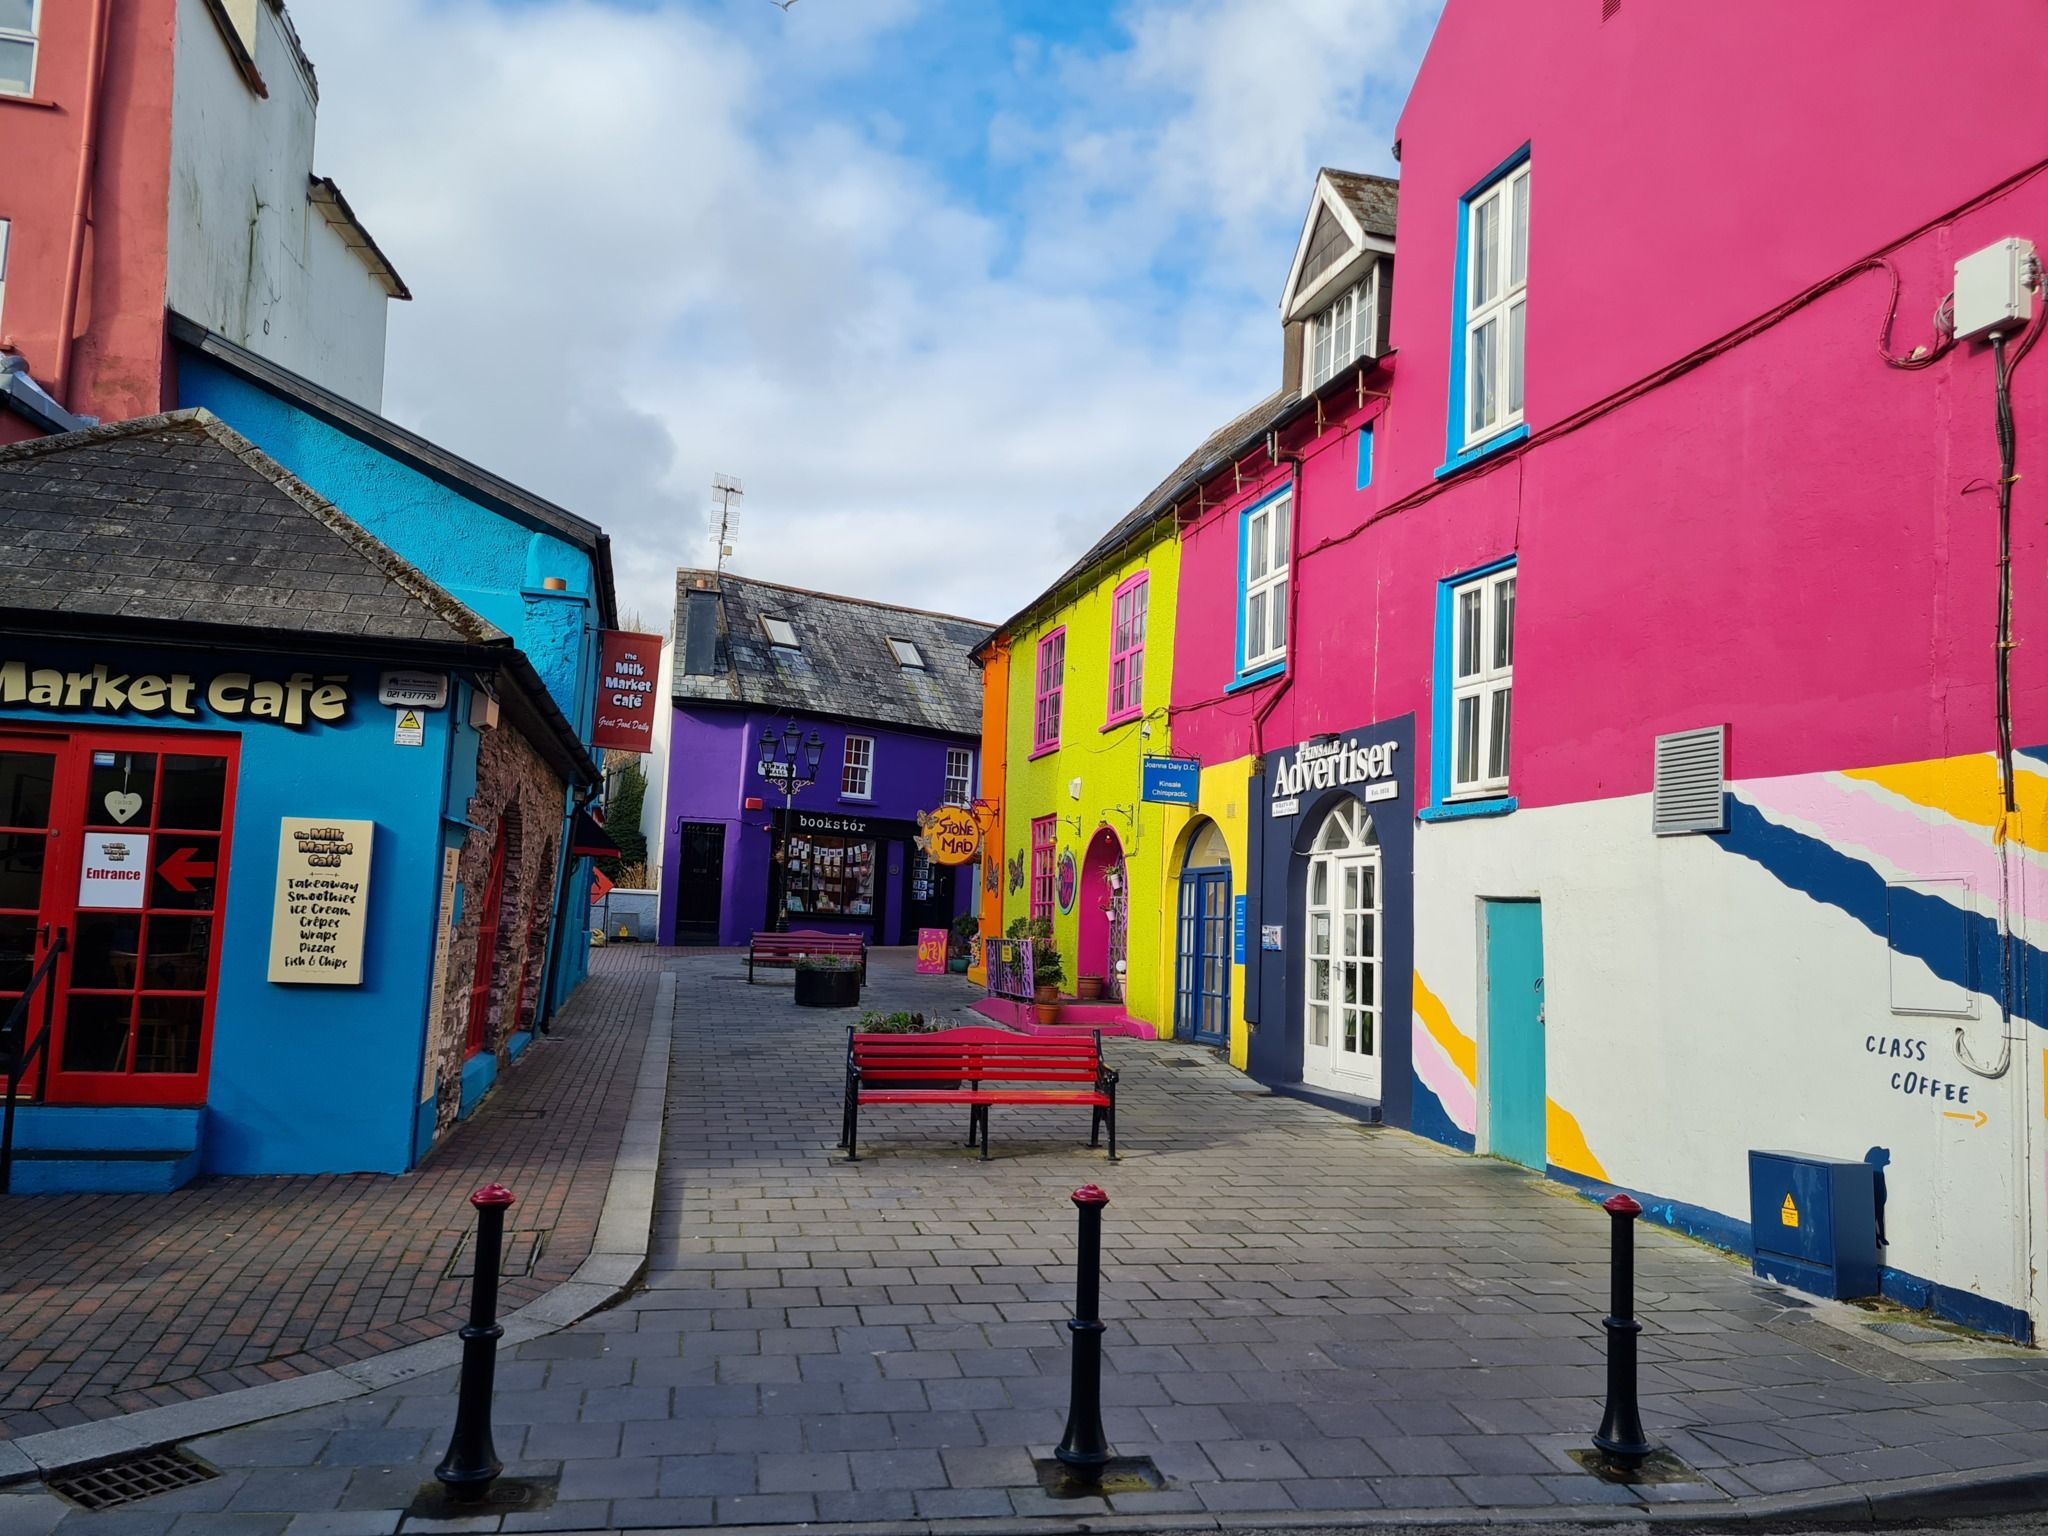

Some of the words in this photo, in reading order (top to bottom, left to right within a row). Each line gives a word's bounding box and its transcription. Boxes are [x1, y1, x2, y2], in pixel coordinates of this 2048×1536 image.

[624, 652, 637, 660] the
[615, 662, 645, 676] Milk
[605, 676, 652, 692] Market
[208, 672, 350, 725] Café
[386, 690, 400, 699] 021
[612, 693, 643, 709] Café
[598, 715, 616, 728] Great
[616, 718, 631, 729] Food
[632, 720, 650, 732] Daily
[1144, 761, 1168, 769] Joanna
[1168, 763, 1182, 771] Daly
[1271, 738, 1399, 798] Advertiser
[1158, 780, 1182, 788] Kinsale
[1151, 789, 1189, 798] Chiropractic
[799, 815, 866, 832] bookstór
[937, 815, 974, 840] STONE
[294, 830, 310, 840] the
[310, 827, 345, 842] Milk
[299, 841, 354, 855] Market
[942, 837, 974, 854] MAD
[308, 854, 342, 868] Café
[86, 867, 141, 881] Entrance
[287, 878, 359, 893] Takeaway
[287, 890, 356, 904] Smoothies
[311, 903, 351, 916] Cream
[300, 916, 340, 930] Crêpes
[300, 930, 338, 943] Wraps
[299, 943, 336, 954] Pizzas
[284, 955, 305, 968] Fish
[308, 955, 316, 967] &
[318, 955, 348, 970] Chips
[1865, 1035, 1927, 1061] CLASS
[1891, 1071, 1970, 1104] COFFEE
